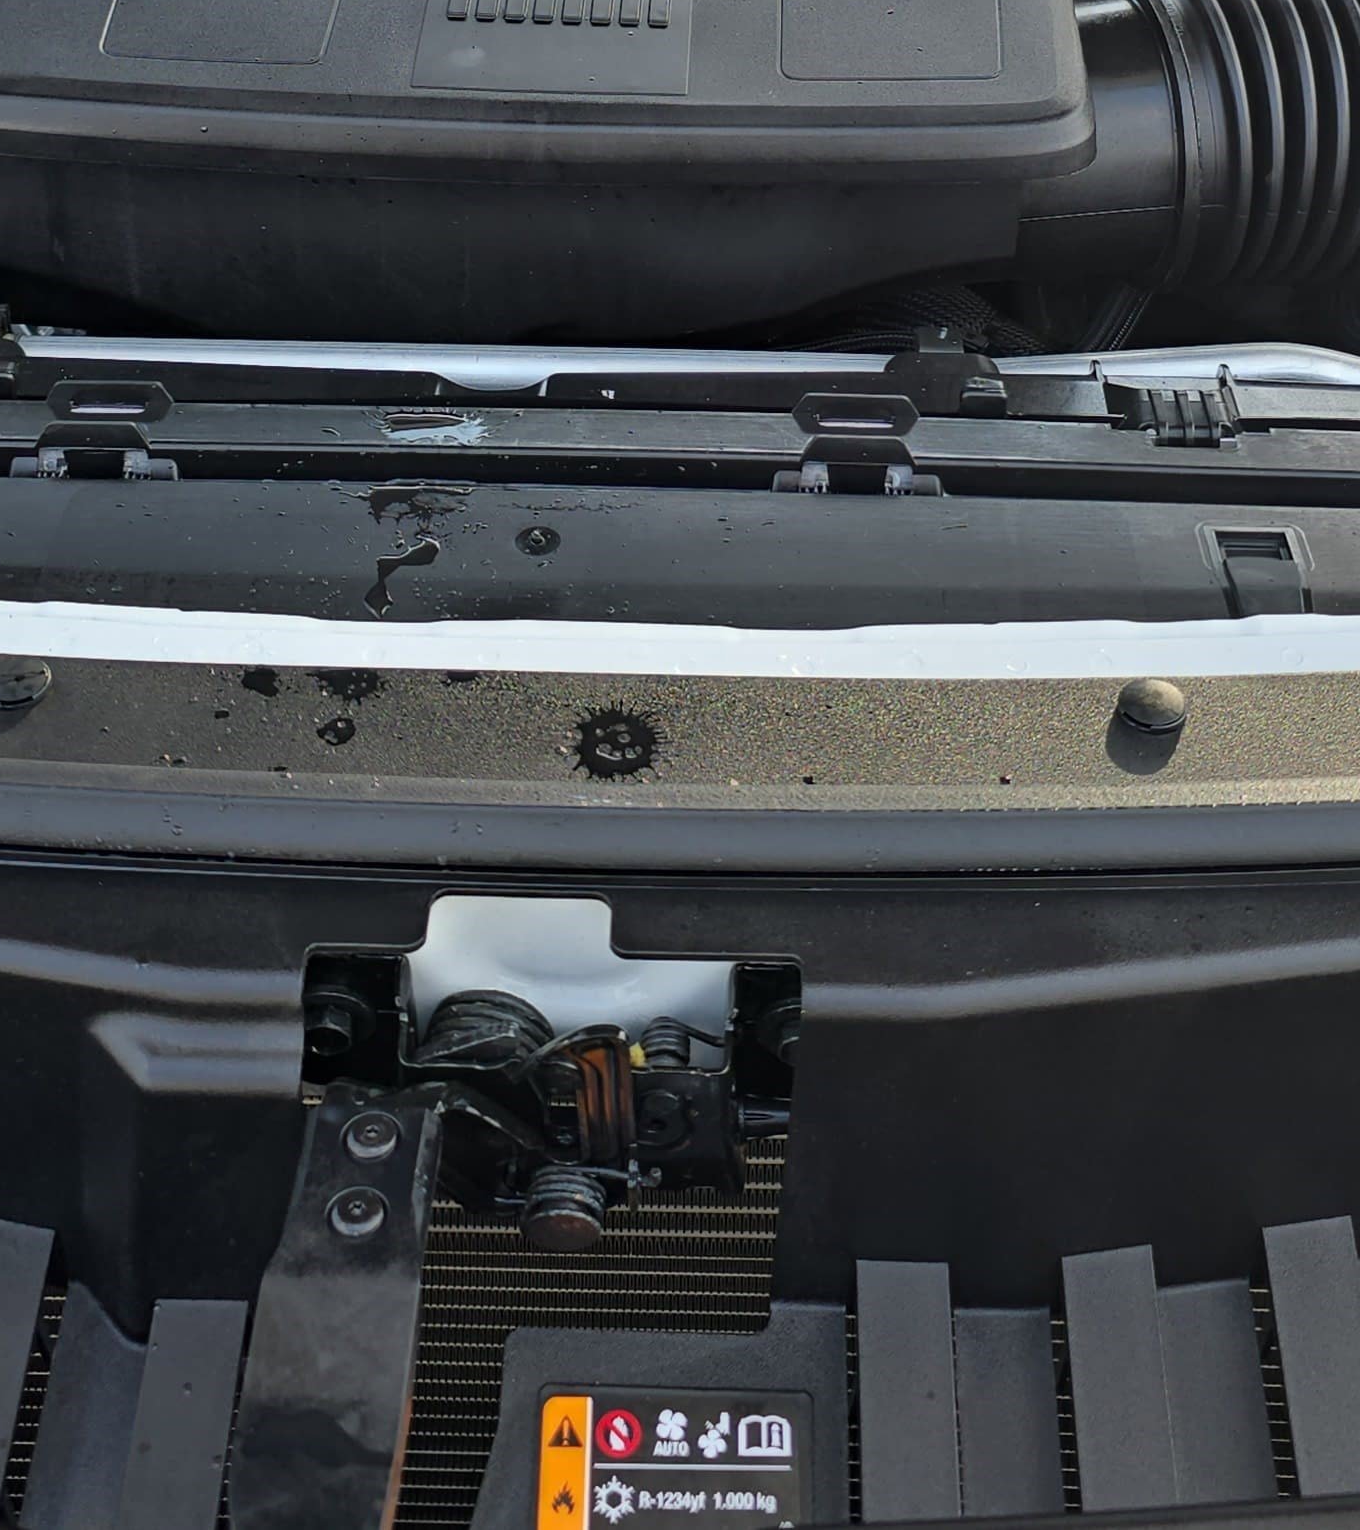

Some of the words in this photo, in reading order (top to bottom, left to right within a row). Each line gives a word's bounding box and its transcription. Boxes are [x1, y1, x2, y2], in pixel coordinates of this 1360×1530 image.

[653, 1440, 690, 1457] AUTO
[639, 1491, 706, 1513] R-1234yf
[713, 1491, 754, 1511] 1.000
[756, 1491, 778, 1514] kg
